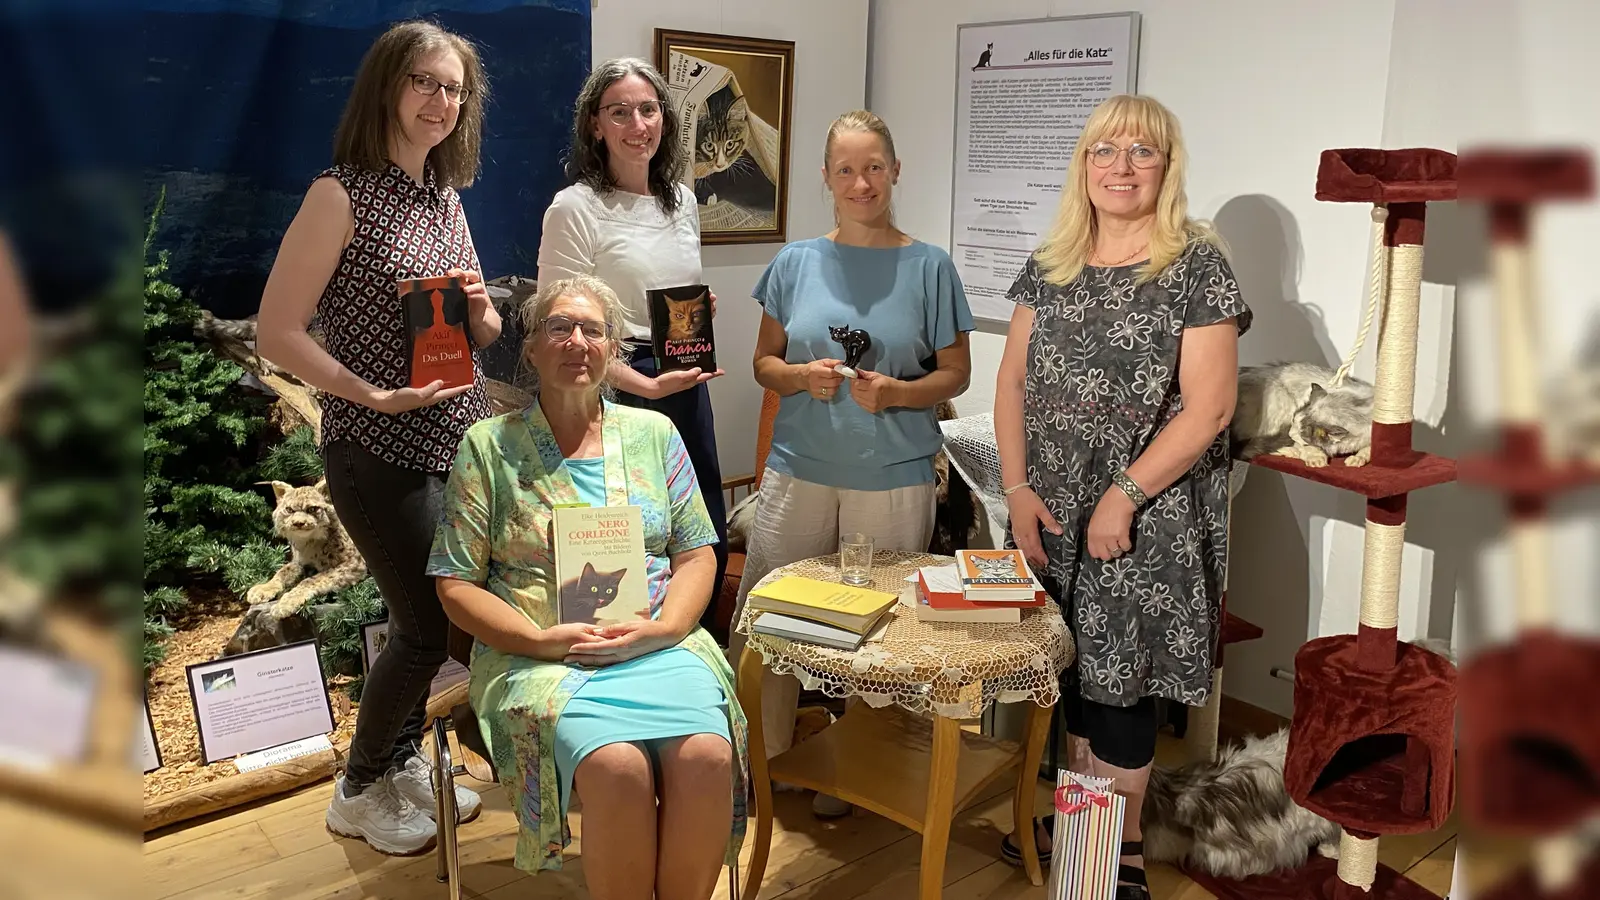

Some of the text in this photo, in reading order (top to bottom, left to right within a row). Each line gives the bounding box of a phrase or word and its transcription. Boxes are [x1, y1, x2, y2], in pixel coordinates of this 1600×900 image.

[1052, 49, 1066, 60] für
[1068, 48, 1083, 59] die
[682, 101, 697, 148] Frankfurter
[433, 329, 451, 340] Akif
[665, 340, 712, 356] Francis
[422, 350, 462, 363] Das Duell
[598, 519, 629, 528] NERO
[569, 529, 630, 540] CORLEONE
[257, 666, 294, 677] Ginsterkatze
[263, 743, 302, 758] Diorama
